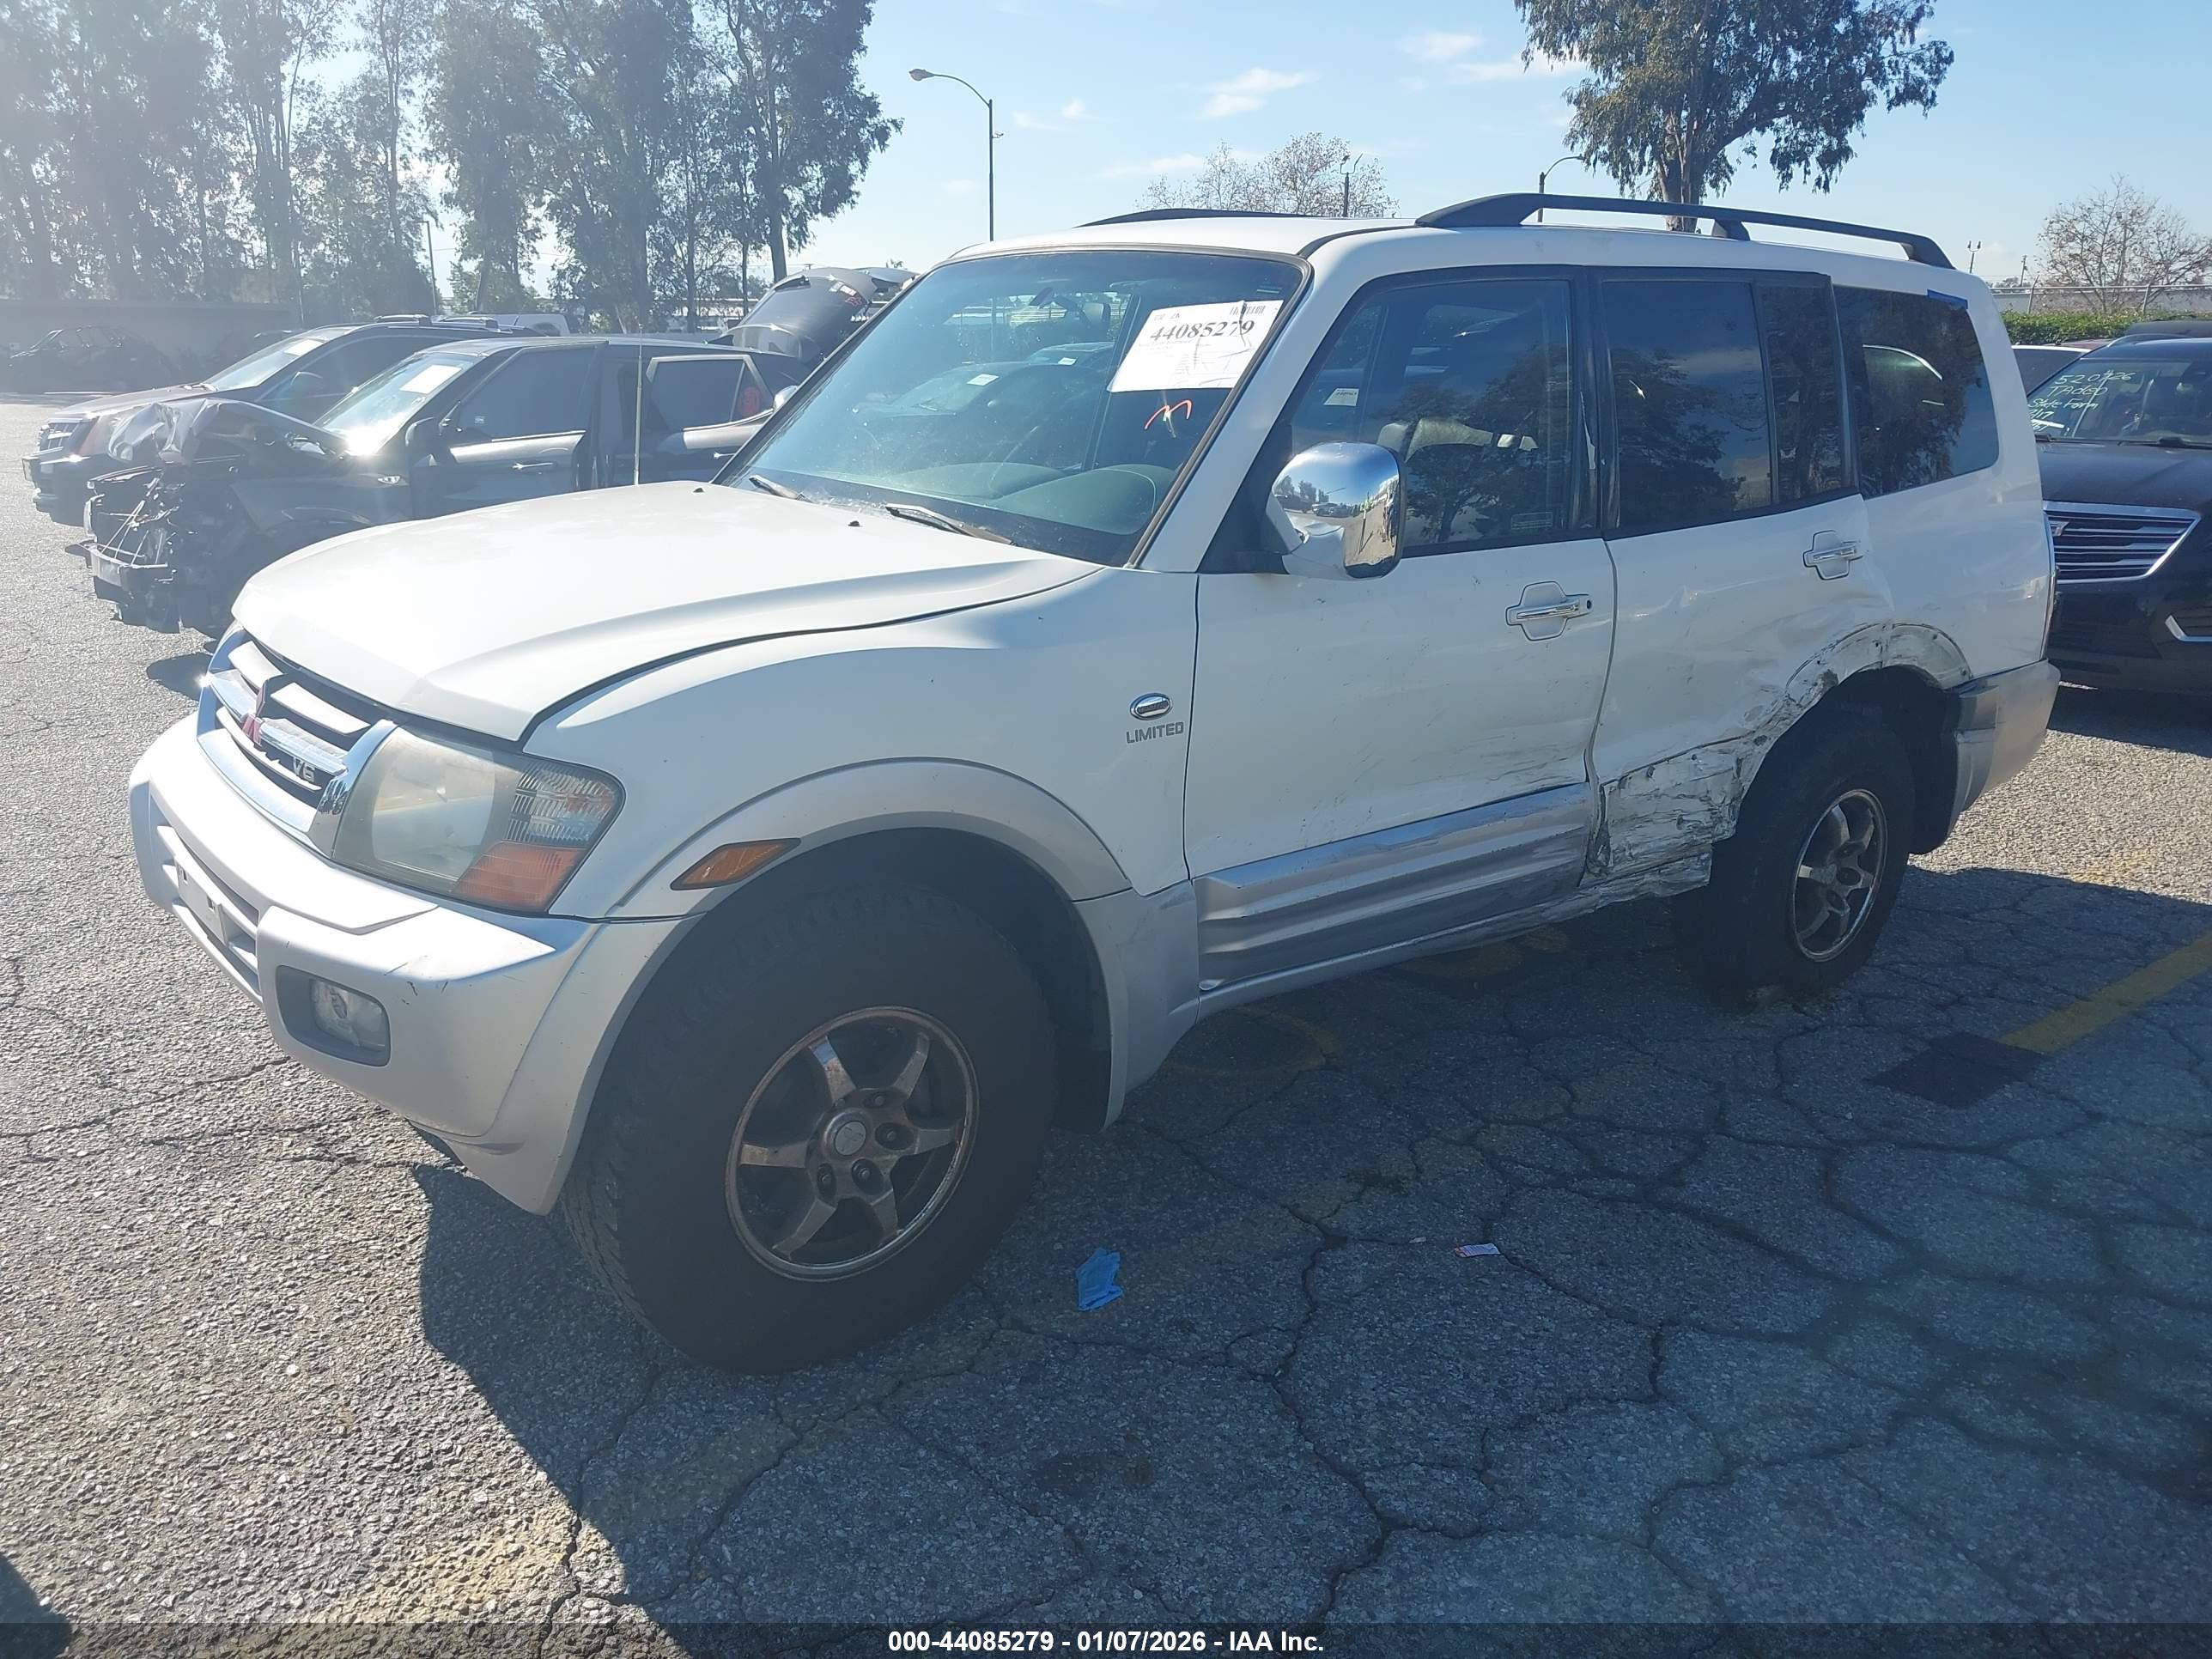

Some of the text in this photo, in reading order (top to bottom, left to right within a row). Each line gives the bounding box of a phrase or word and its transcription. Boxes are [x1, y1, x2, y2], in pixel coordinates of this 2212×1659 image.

[1150, 319, 1255, 341] 44085279
[1126, 721, 1184, 744] LIMITED
[292, 757, 316, 783] V6
